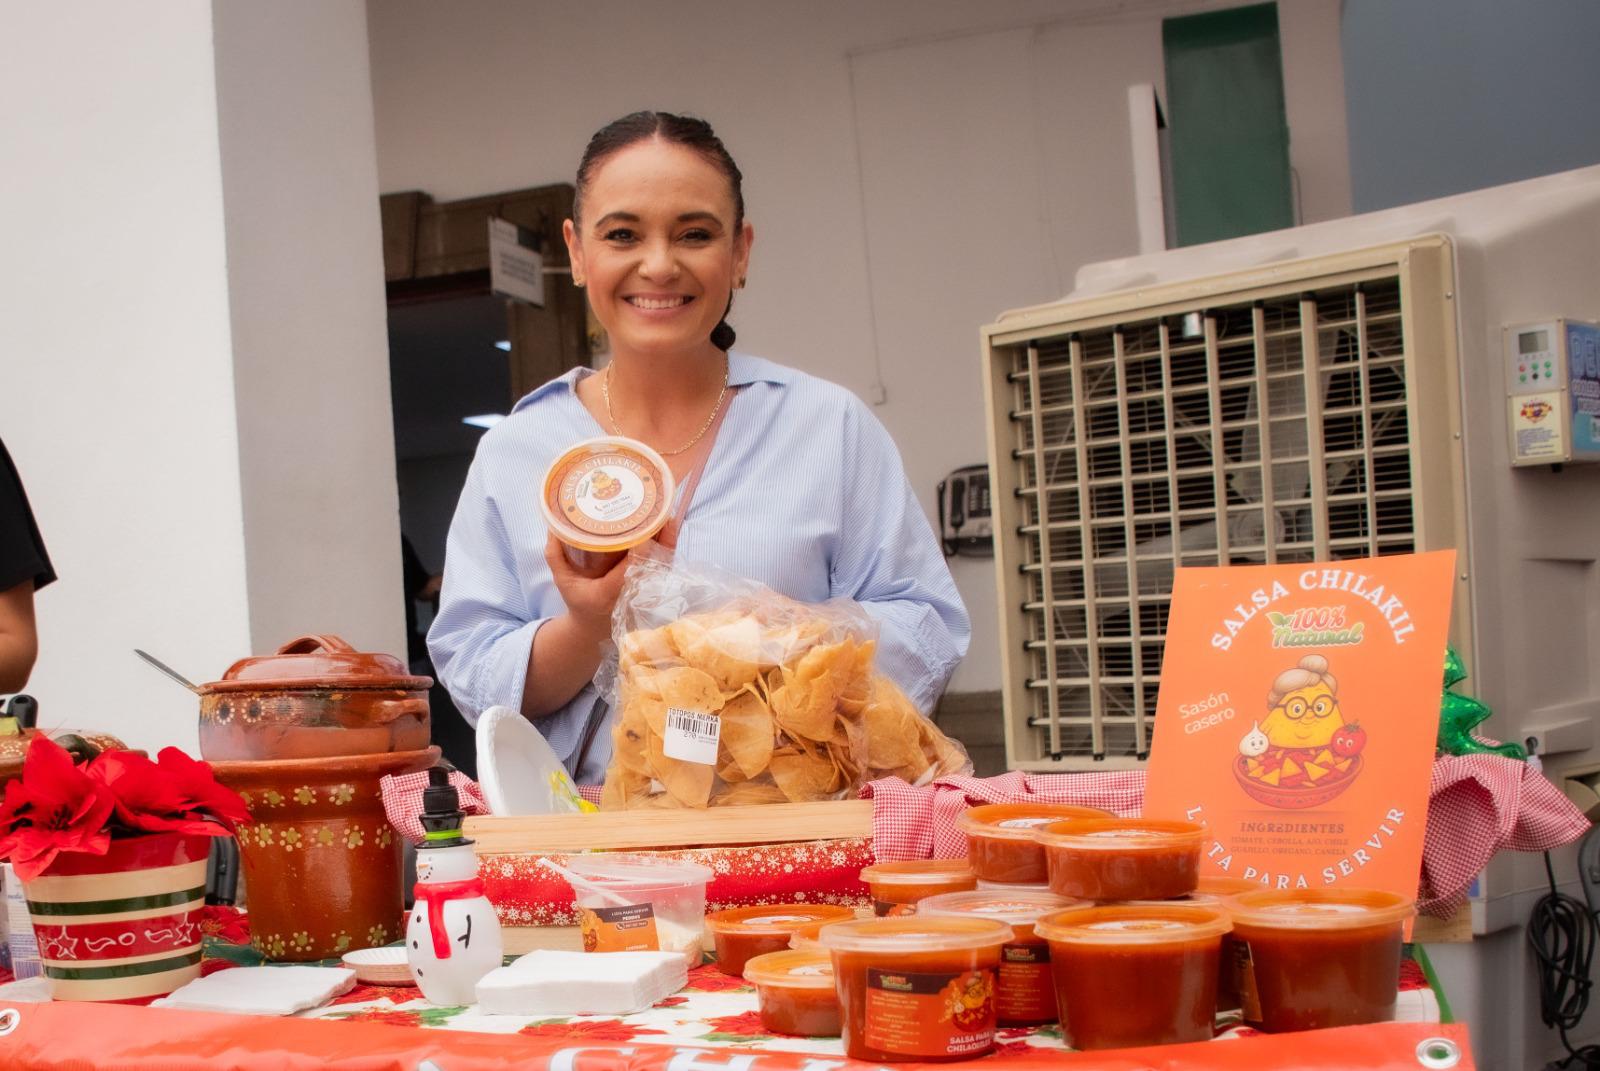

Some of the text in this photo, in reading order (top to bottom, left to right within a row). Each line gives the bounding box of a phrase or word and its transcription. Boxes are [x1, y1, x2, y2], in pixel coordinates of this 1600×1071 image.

[1211, 569, 1415, 650] SALSA CHILAKIL
[1291, 605, 1346, 631] 100%
[1272, 623, 1365, 649] Natural
[1178, 692, 1230, 719] Sasón
[1184, 707, 1235, 734] casero
[1240, 822, 1345, 834] INGREDIENTES
[1186, 806, 1405, 890] LTA PARA SERVIR
[1324, 838, 1349, 846] CHILE
[949, 1034, 975, 1045] SALSA
